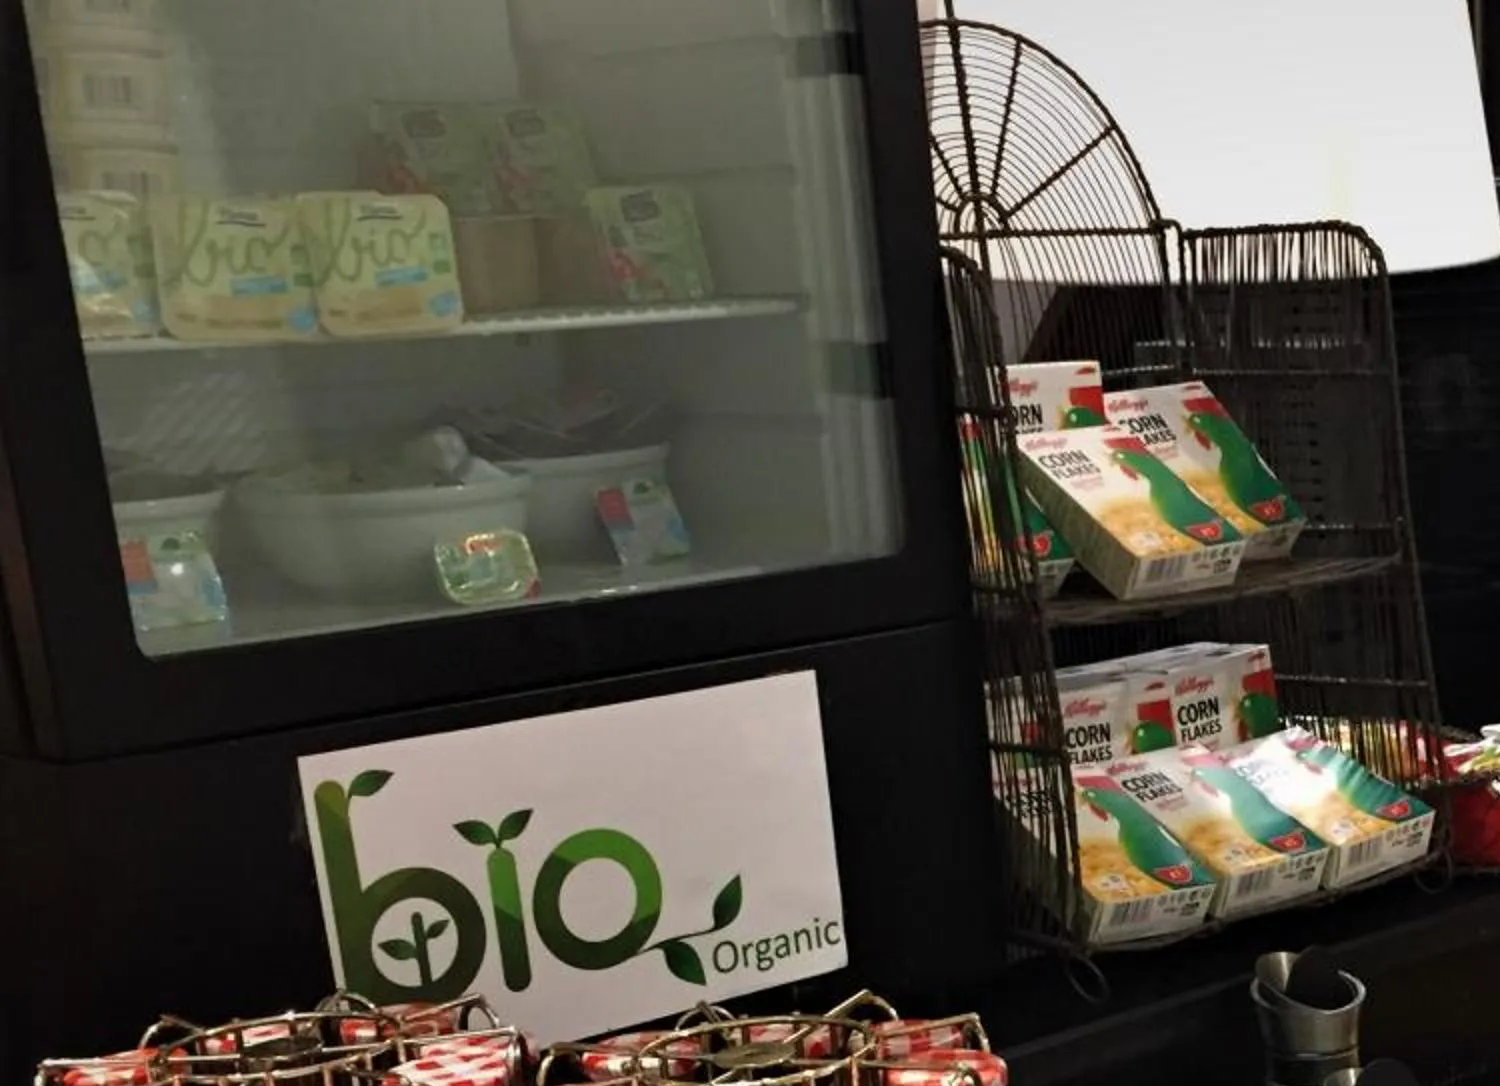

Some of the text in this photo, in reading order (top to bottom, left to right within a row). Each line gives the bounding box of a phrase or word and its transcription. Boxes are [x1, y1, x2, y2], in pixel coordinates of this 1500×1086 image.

[1009, 403, 1043, 426] ORN
[1038, 449, 1090, 469] CORN
[1050, 463, 1102, 480] FLAKES
[1177, 695, 1220, 726] CORN
[1065, 722, 1111, 749] CORN
[1181, 719, 1223, 742] FLAKES
[1068, 744, 1113, 765] FLAKES
[1121, 771, 1172, 793] CORN
[1136, 783, 1183, 803] FLAKES
[315, 770, 662, 1003] bio
[711, 916, 842, 975] Organic
